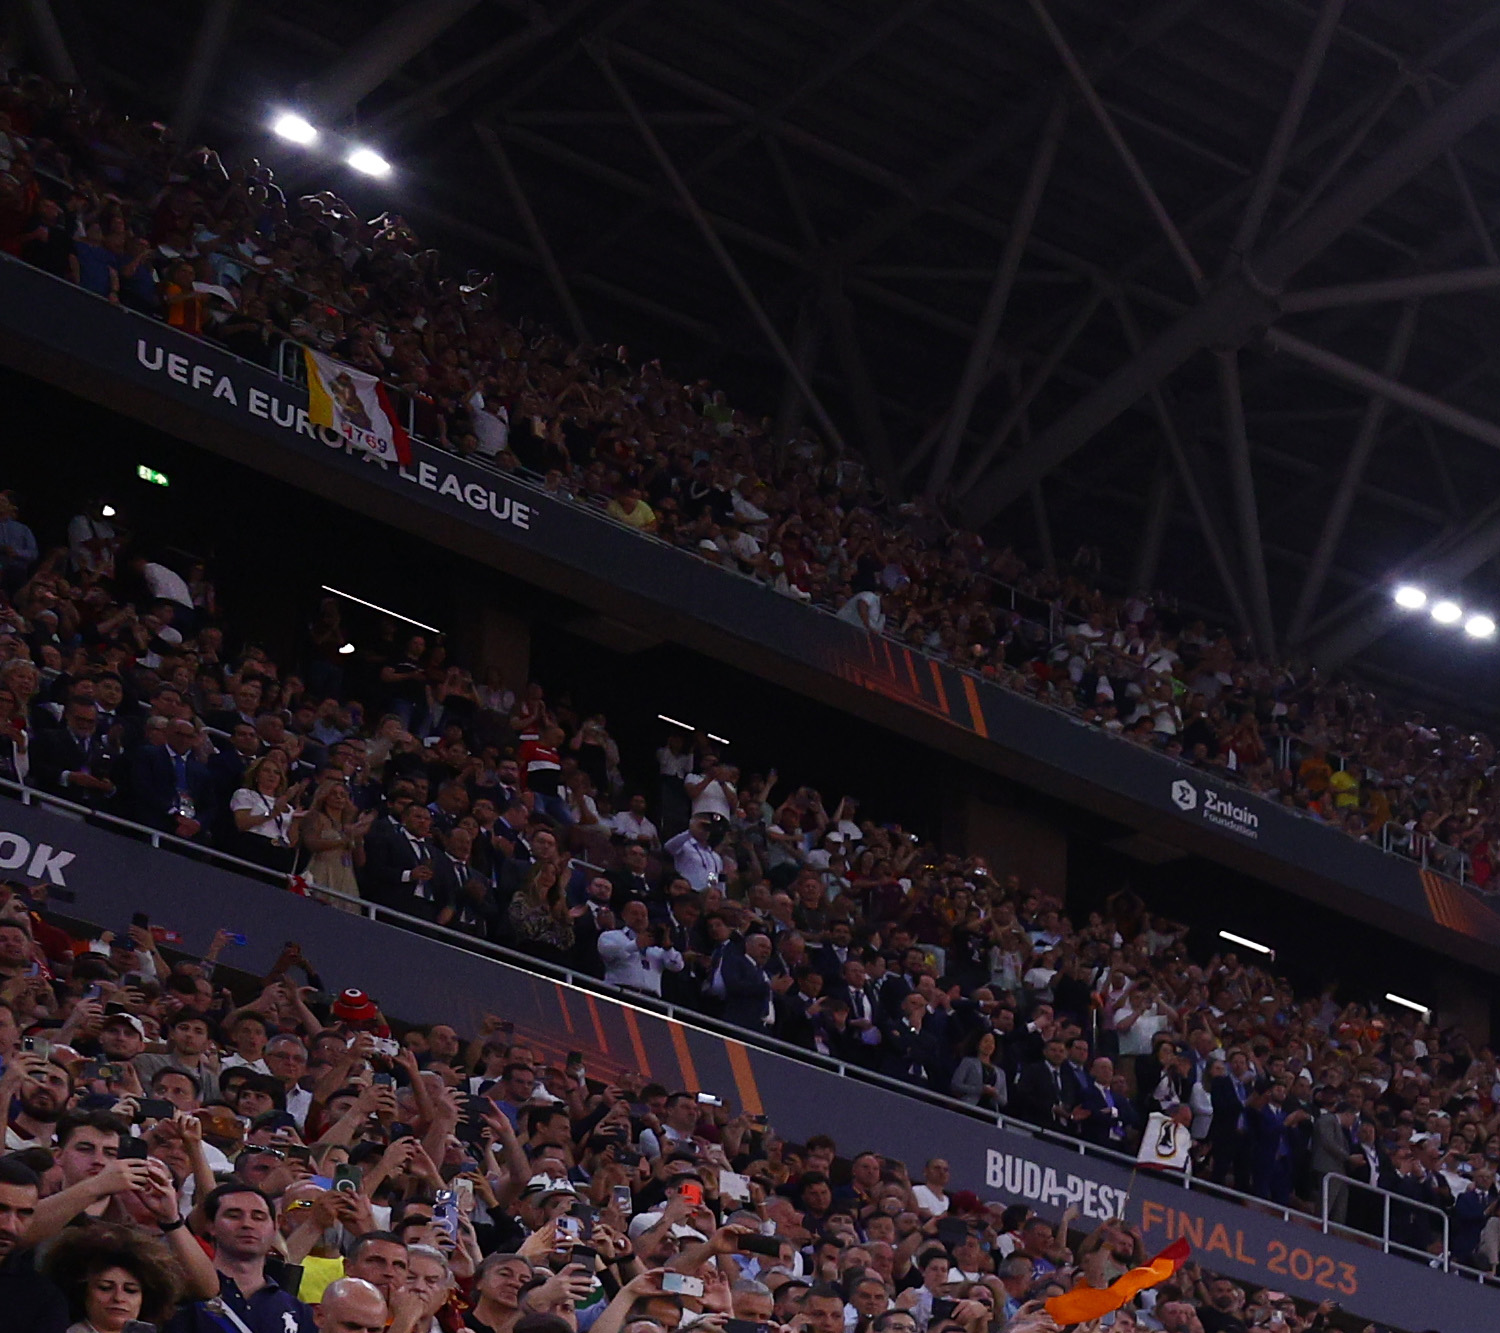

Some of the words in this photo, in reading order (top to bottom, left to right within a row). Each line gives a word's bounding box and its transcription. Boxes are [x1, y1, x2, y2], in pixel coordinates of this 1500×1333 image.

[136, 338, 238, 407] UEFA
[247, 386, 390, 471] EURO
[397, 461, 531, 530] LEAGUE
[1202, 810, 1259, 840] Foundation
[1141, 1201, 1256, 1266] FINAL
[1266, 1240, 1358, 1296] 2023
